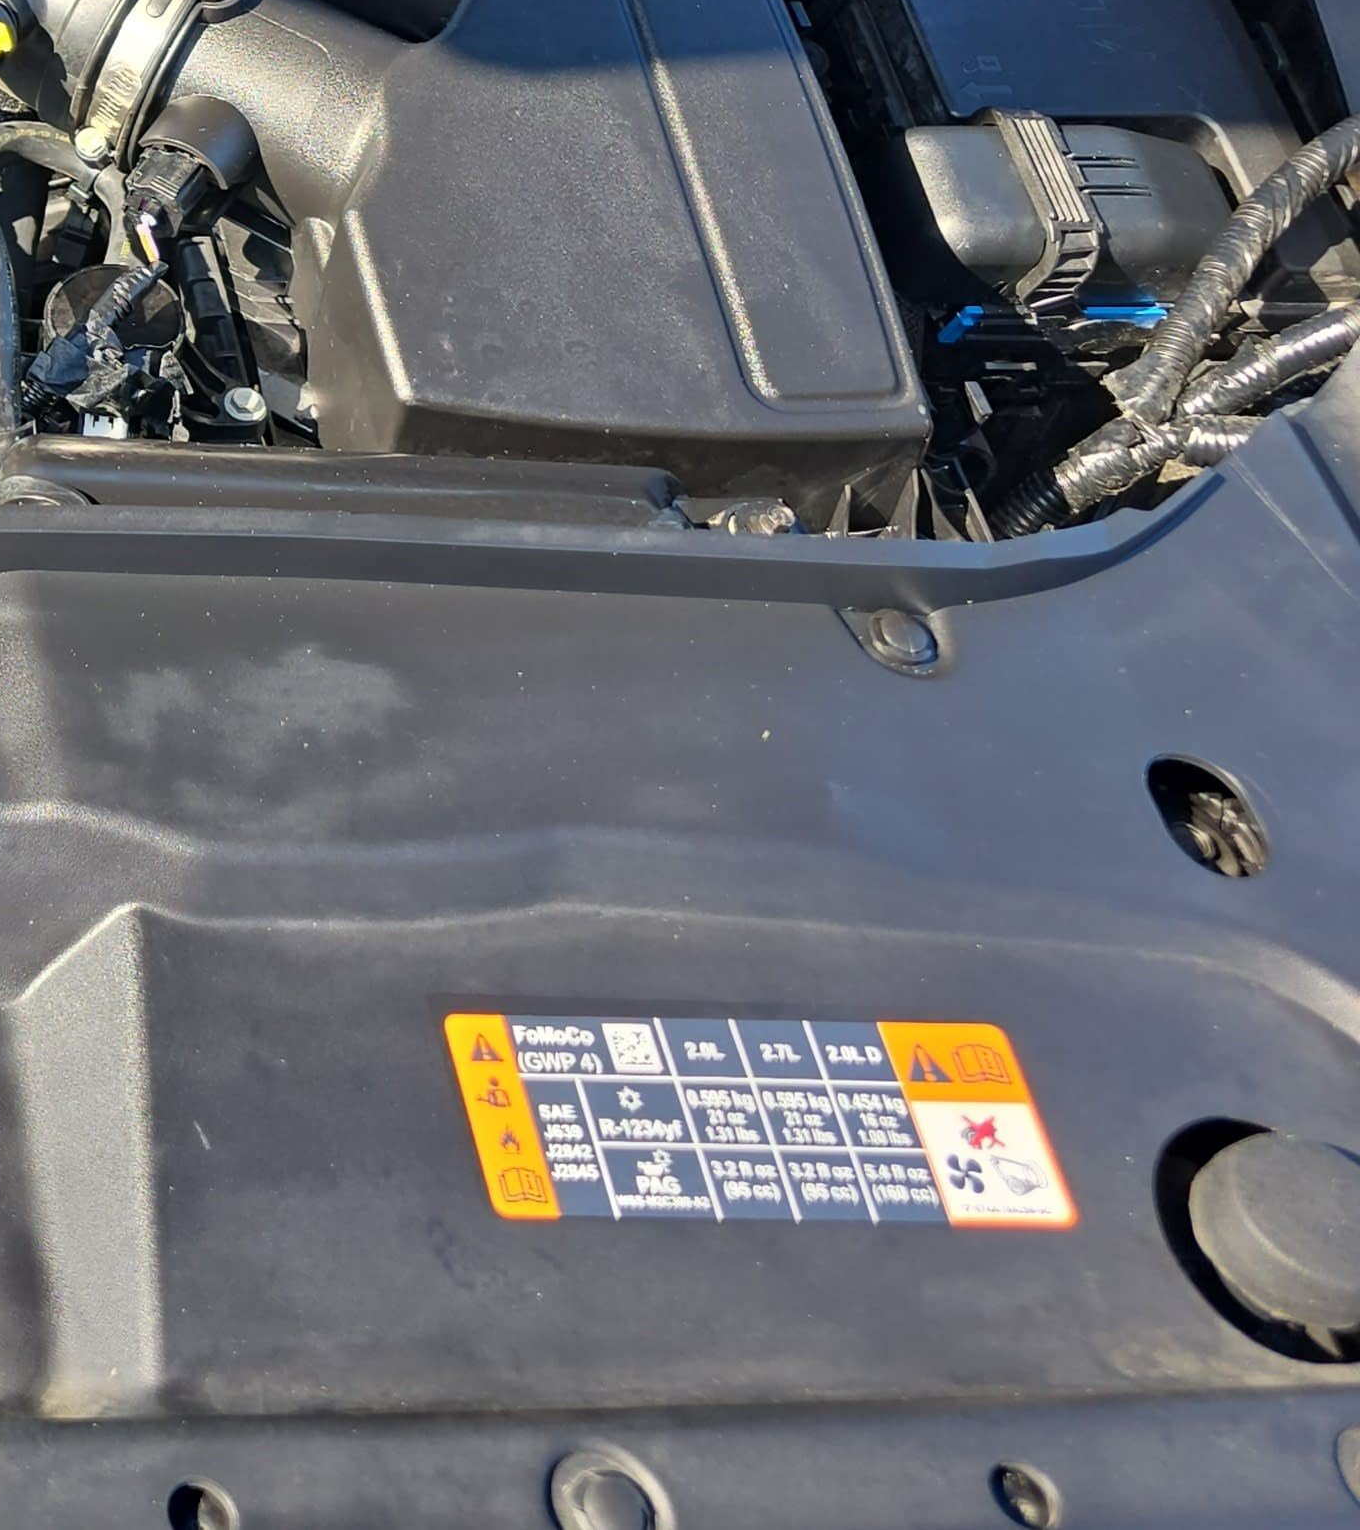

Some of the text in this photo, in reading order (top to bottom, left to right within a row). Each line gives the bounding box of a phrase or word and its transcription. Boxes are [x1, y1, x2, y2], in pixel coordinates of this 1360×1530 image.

[511, 1024, 596, 1047] FoMoCo
[683, 1041, 727, 1062] 2.0L
[759, 1043, 802, 1063] 2.7L
[825, 1044, 883, 1065] 2.0L D
[516, 1051, 604, 1074] (GWP 4)
[685, 1088, 757, 1113] 0.595 kg
[761, 1090, 833, 1115] 0.595 kg
[836, 1091, 908, 1117] 0.454 kg
[538, 1103, 578, 1120] SAE
[705, 1108, 748, 1126] 21 oz
[782, 1110, 824, 1128] 21 oz
[858, 1111, 900, 1130] 16 oz
[543, 1123, 585, 1141] J639
[598, 1117, 684, 1141] R-1234yf
[704, 1125, 762, 1145] 1.31 lbs
[781, 1126, 838, 1146] 1.31 lbs
[884, 1129, 913, 1149] lbs
[545, 1143, 595, 1161] J2842
[551, 1163, 601, 1183] J2845
[709, 1160, 779, 1179] 3.2 fl oz
[787, 1161, 856, 1181] 3.2 fl oz
[862, 1163, 932, 1183] 5.4 fl oz
[635, 1175, 682, 1195] PAG
[723, 1180, 782, 1206] (95 cc)
[800, 1181, 859, 1208] (95 cc)
[871, 1183, 940, 1209] (160 cc)
